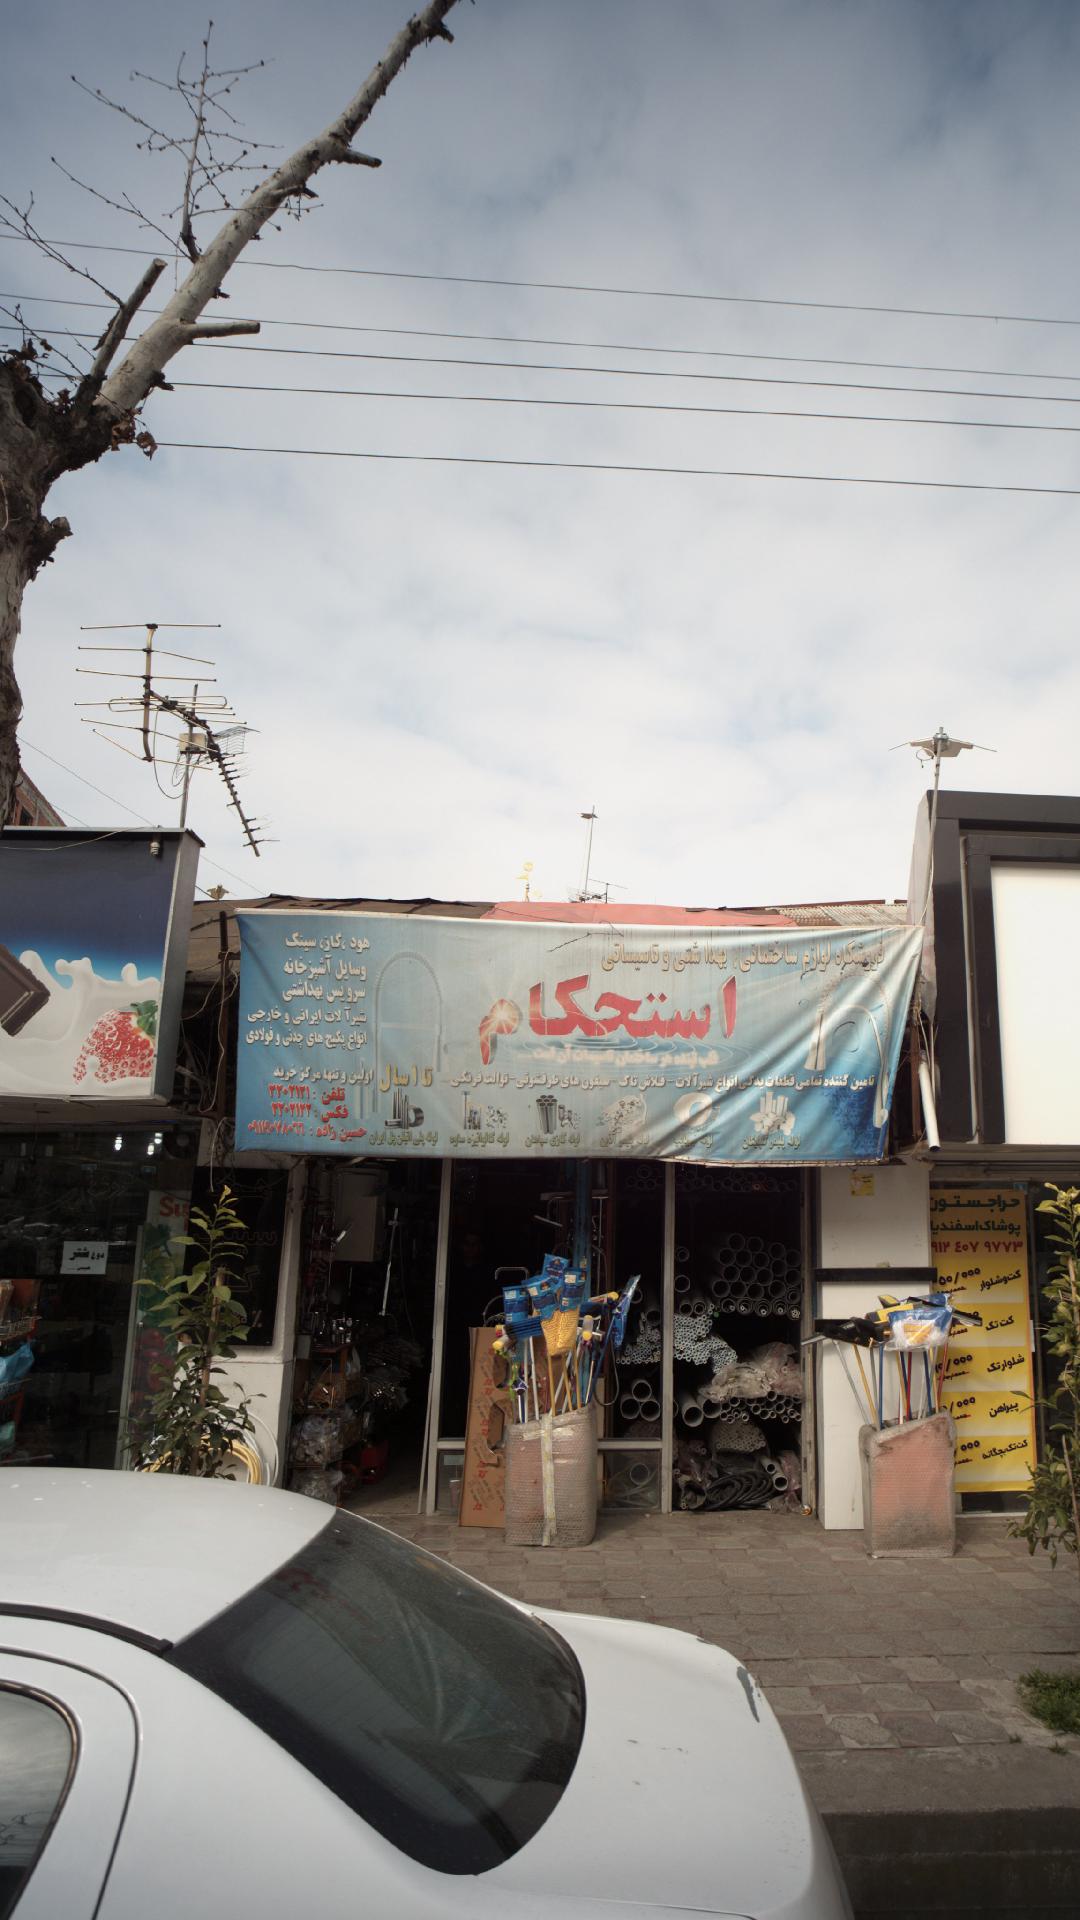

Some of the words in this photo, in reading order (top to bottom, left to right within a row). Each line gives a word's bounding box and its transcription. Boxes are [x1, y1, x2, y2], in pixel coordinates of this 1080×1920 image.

[283, 953, 333, 980] آشپزخانه
[335, 958, 368, 981] وسایل
[281, 979, 323, 1002] بهداشتی
[326, 984, 367, 1003] سرویس
[247, 1004, 282, 1022] خارجی
[479, 973, 737, 1066] استحکام
[320, 1085, 346, 1106] تلفن
[320, 1103, 350, 1123] فکس
[929, 1218, 979, 1236] اسفندیا
[930, 1241, 950, 1254] ۹۱۲
